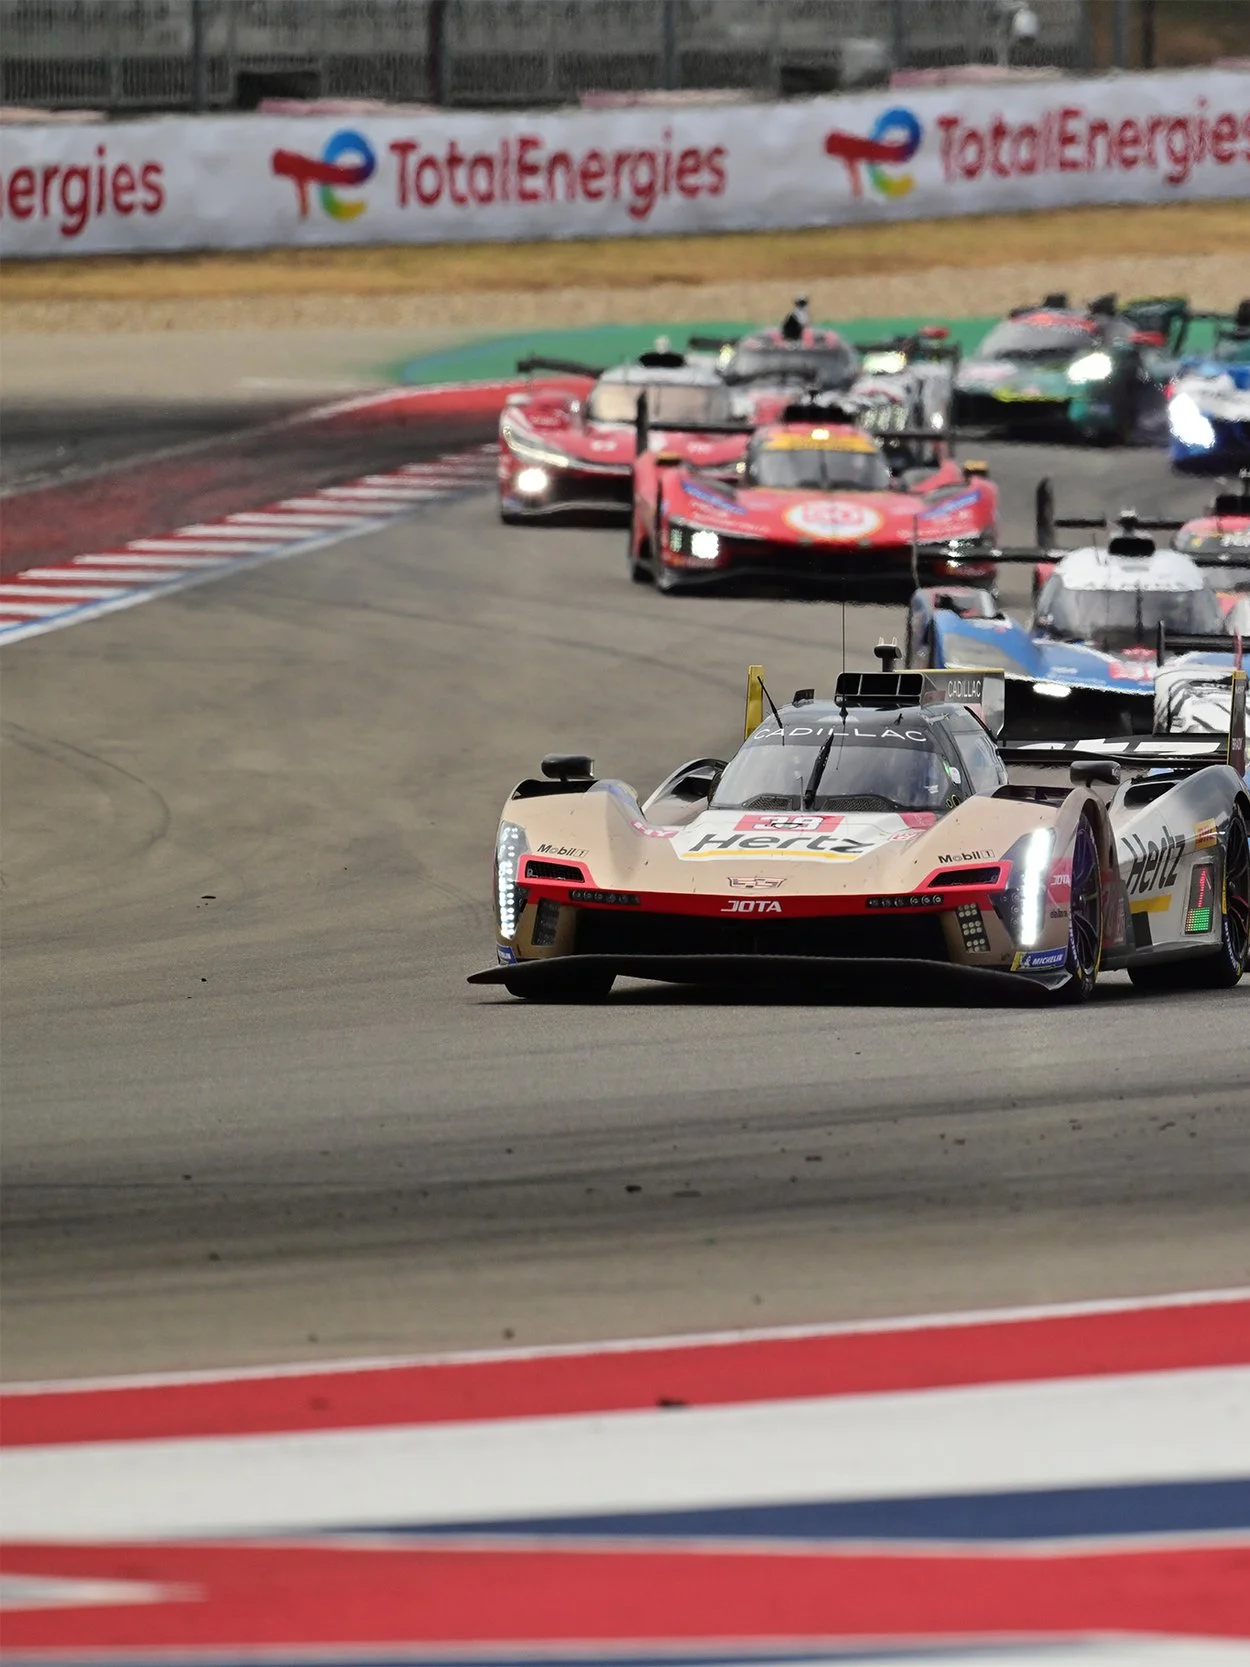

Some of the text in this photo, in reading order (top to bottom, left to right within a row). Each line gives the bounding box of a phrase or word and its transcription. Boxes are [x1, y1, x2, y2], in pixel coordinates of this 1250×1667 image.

[389, 126, 727, 221] TotalEnergies
[0, 144, 163, 238] ergies
[948, 680, 981, 698] CADILLAC
[754, 727, 927, 742] CADILLAC
[688, 833, 876, 854] Hertz
[1121, 825, 1185, 895] Hertz
[721, 900, 782, 912] JOTA
